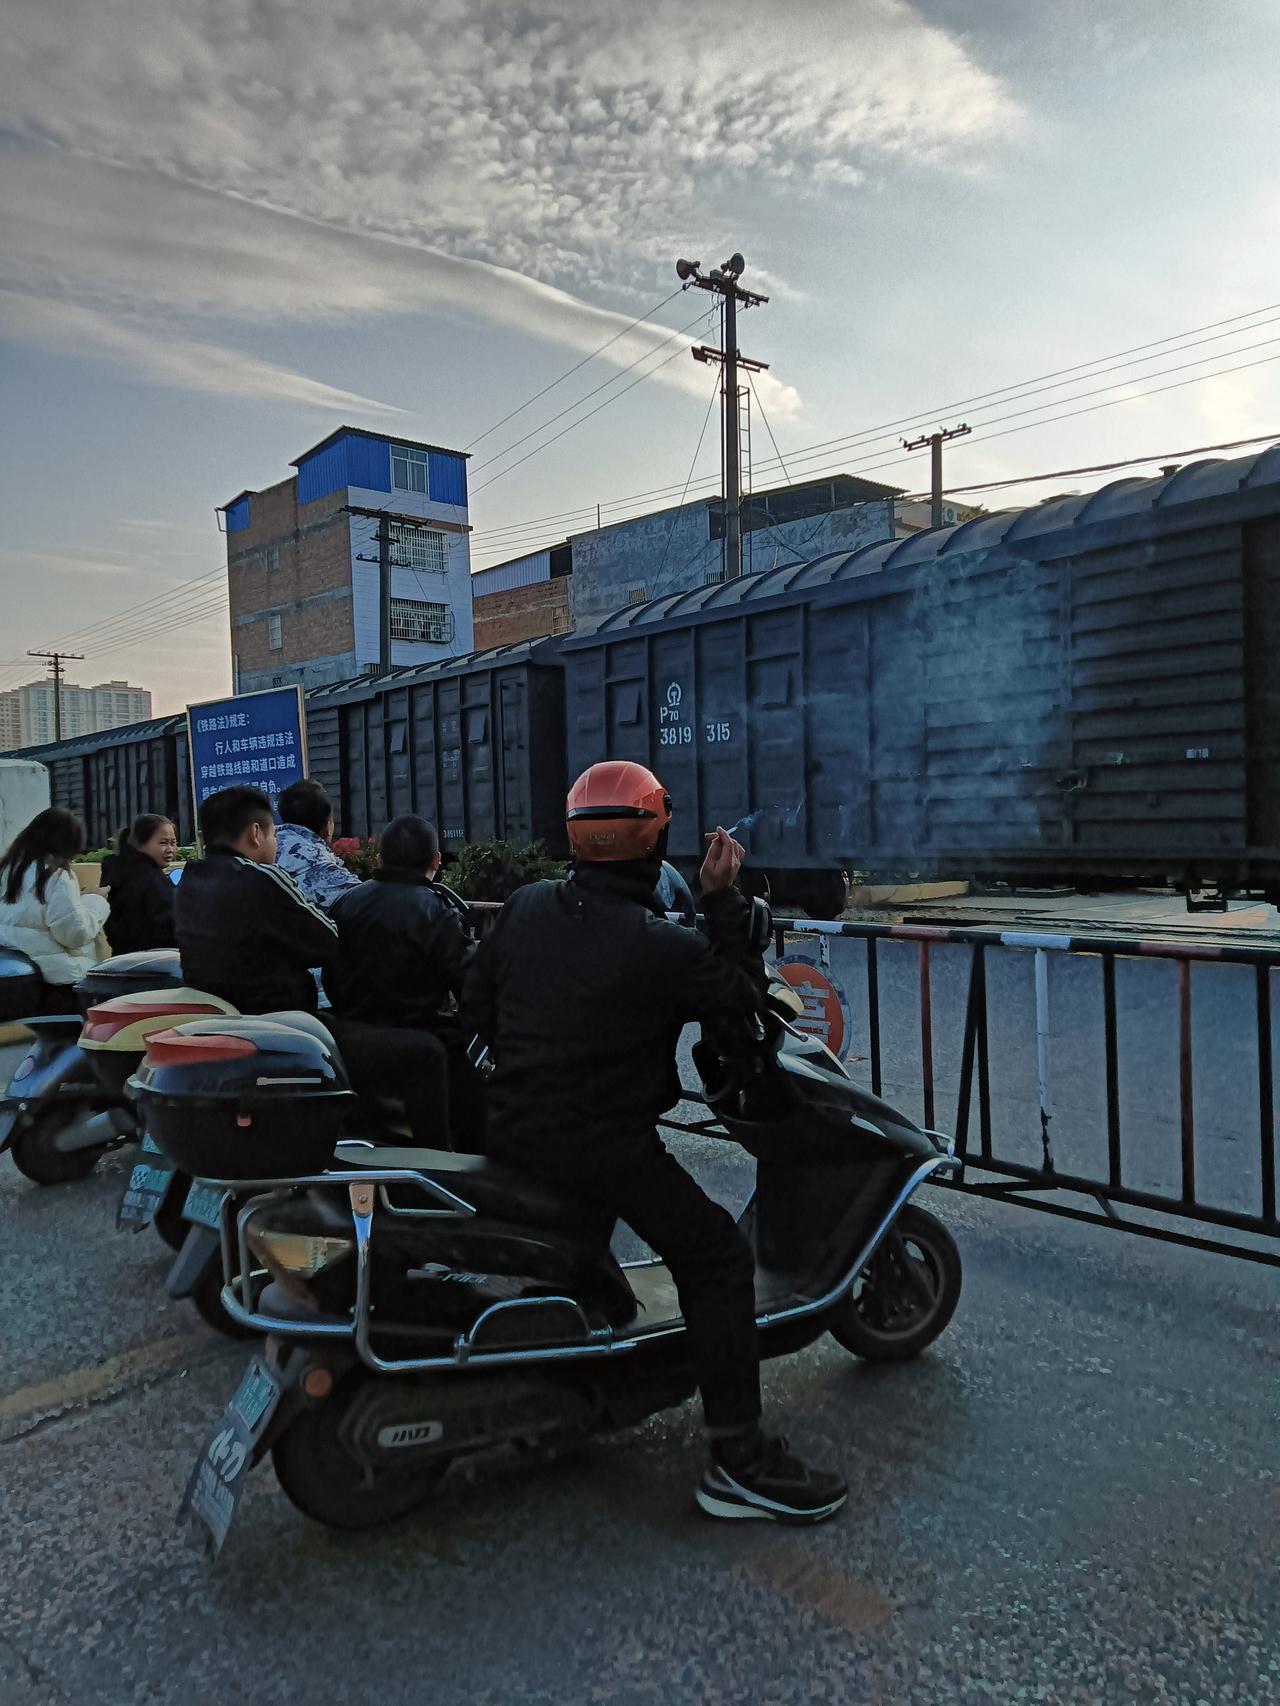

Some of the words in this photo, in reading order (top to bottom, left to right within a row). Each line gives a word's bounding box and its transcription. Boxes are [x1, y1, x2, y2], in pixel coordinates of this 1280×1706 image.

[214, 730, 295, 756] 行人和车辆违规违法
[660, 726, 692, 745] 3819
[706, 722, 731, 743] 315
[200, 753, 296, 779] 穿越铁路线路和道口造成
